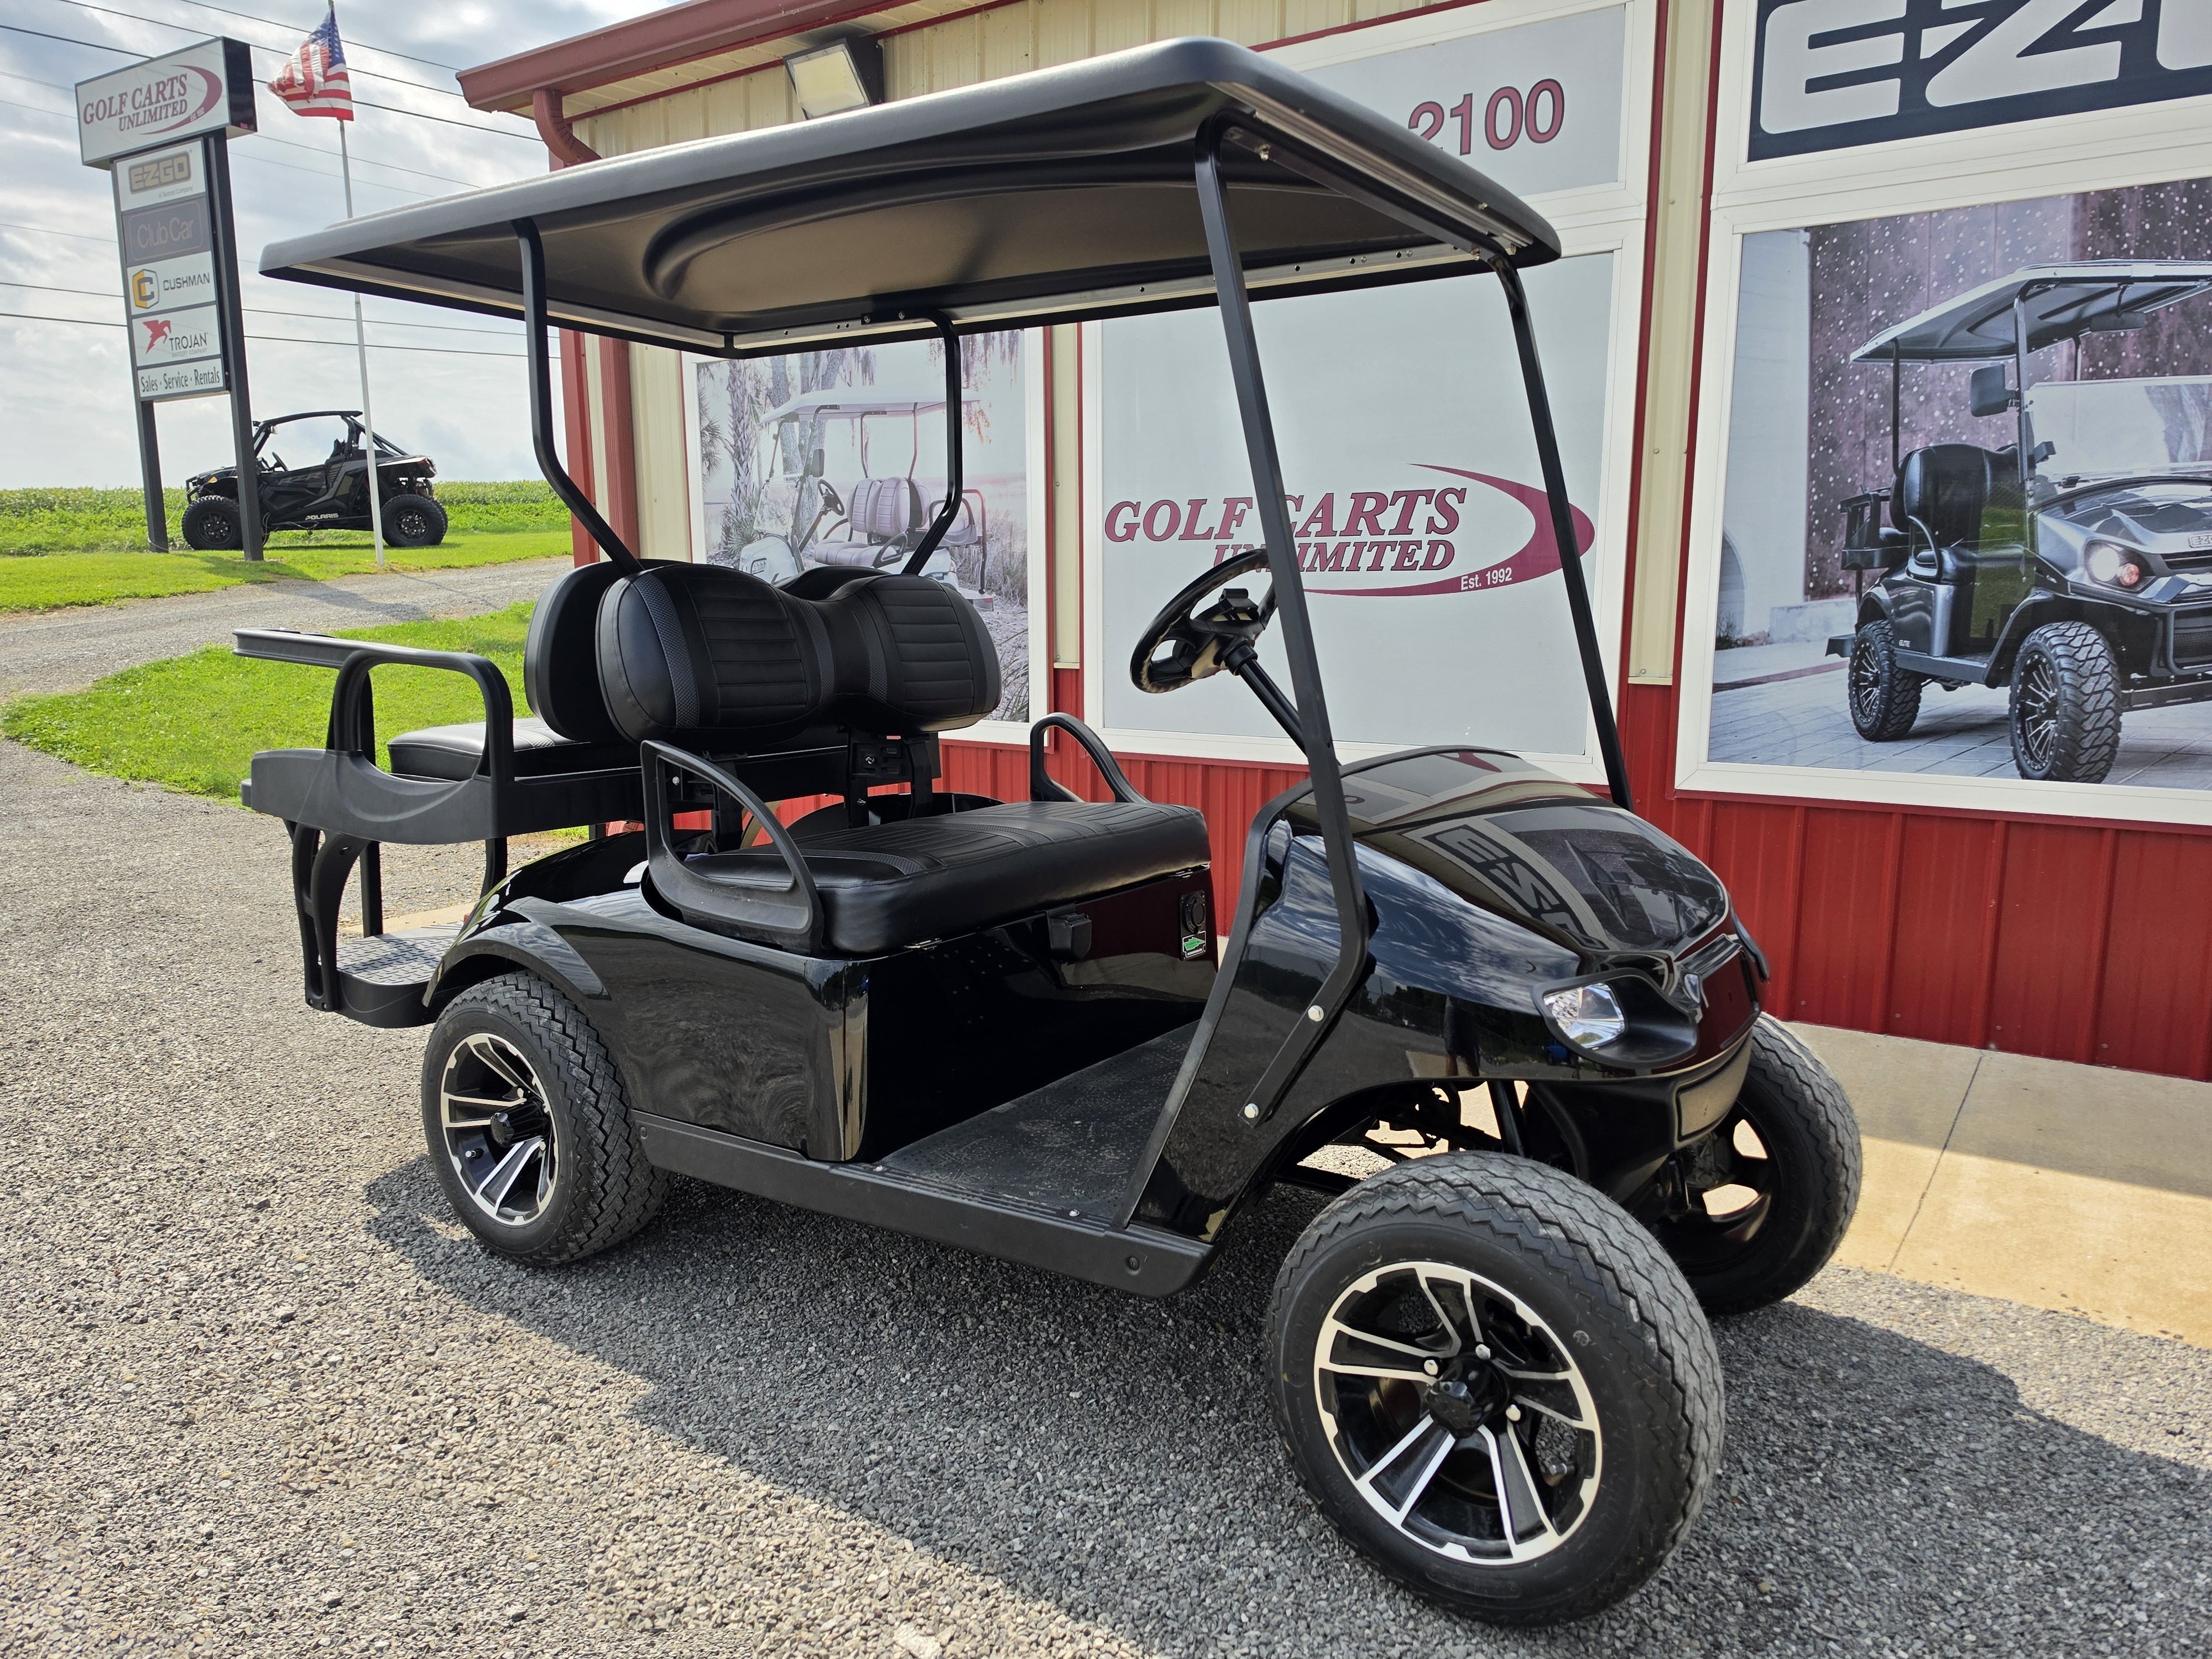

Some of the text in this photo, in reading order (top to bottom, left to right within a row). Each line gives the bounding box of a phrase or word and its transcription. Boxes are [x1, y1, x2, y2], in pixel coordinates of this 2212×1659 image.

[1760, 0, 2212, 134] EZ
[83, 73, 187, 124] GOLF CARTS
[119, 98, 187, 132] UNLIMITED
[1408, 78, 1565, 156] 2100
[130, 156, 189, 190] EZGO
[137, 216, 194, 248] Club Car
[163, 273, 211, 291] CUSHMAN
[169, 332, 208, 351] TROJAN
[141, 366, 220, 392] Sales Service Rentals
[1104, 497, 1253, 542] GOLF
[2191, 535, 2212, 546] EZ
[1461, 567, 1512, 590] Est. 1992
